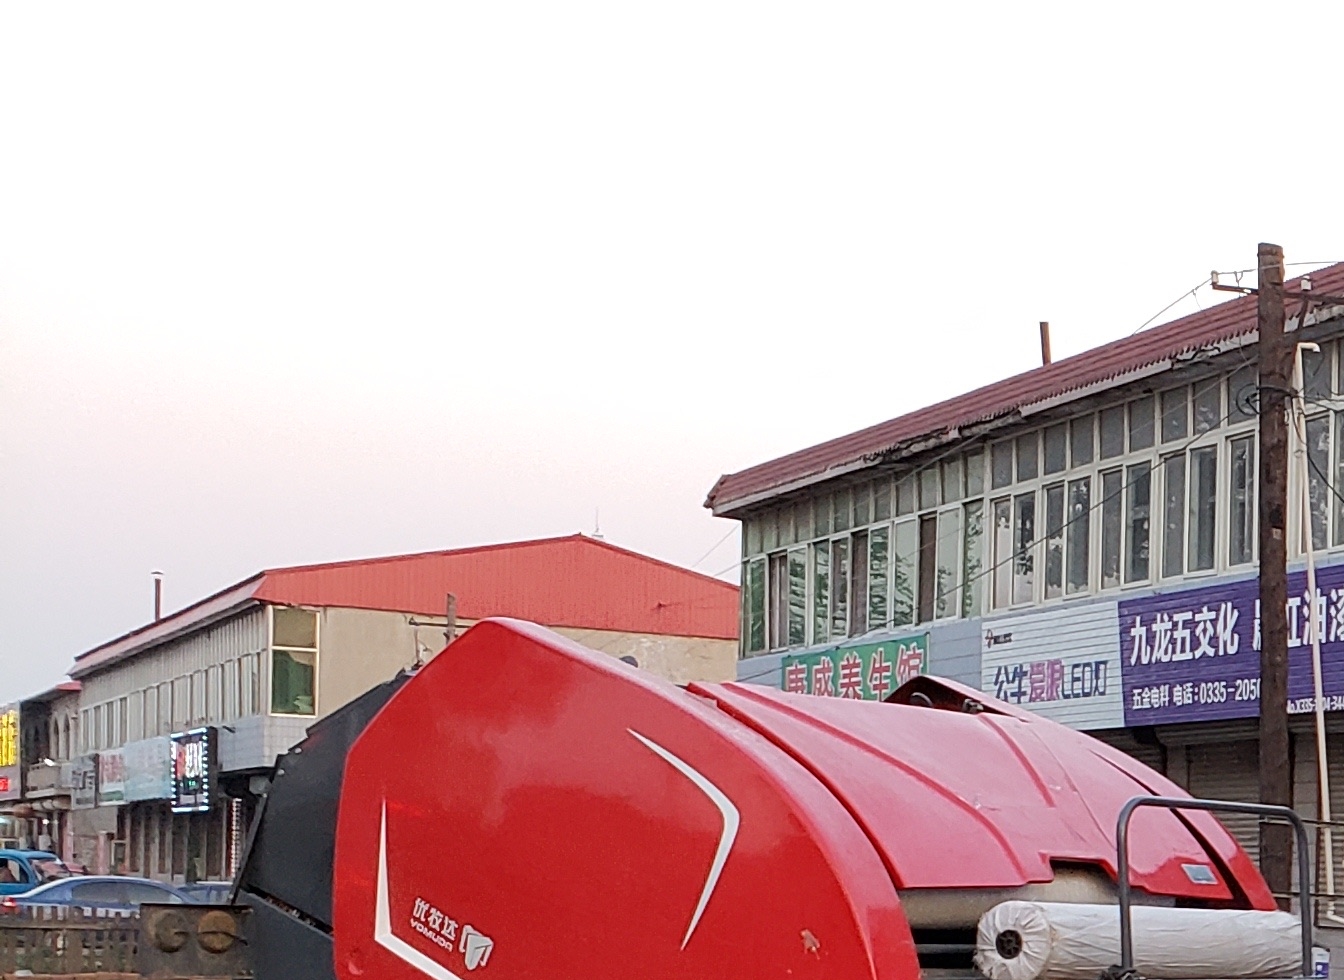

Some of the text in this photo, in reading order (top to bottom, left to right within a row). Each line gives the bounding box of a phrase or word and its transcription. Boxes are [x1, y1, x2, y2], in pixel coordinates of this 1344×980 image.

[1130, 602, 1240, 666] 九龙五交化
[994, 659, 1108, 704] 公牛爱眼LED灯
[1132, 684, 1170, 710] 五金电料
[410, 918, 453, 952] YOMUDA
[413, 897, 458, 941] 优牧达
